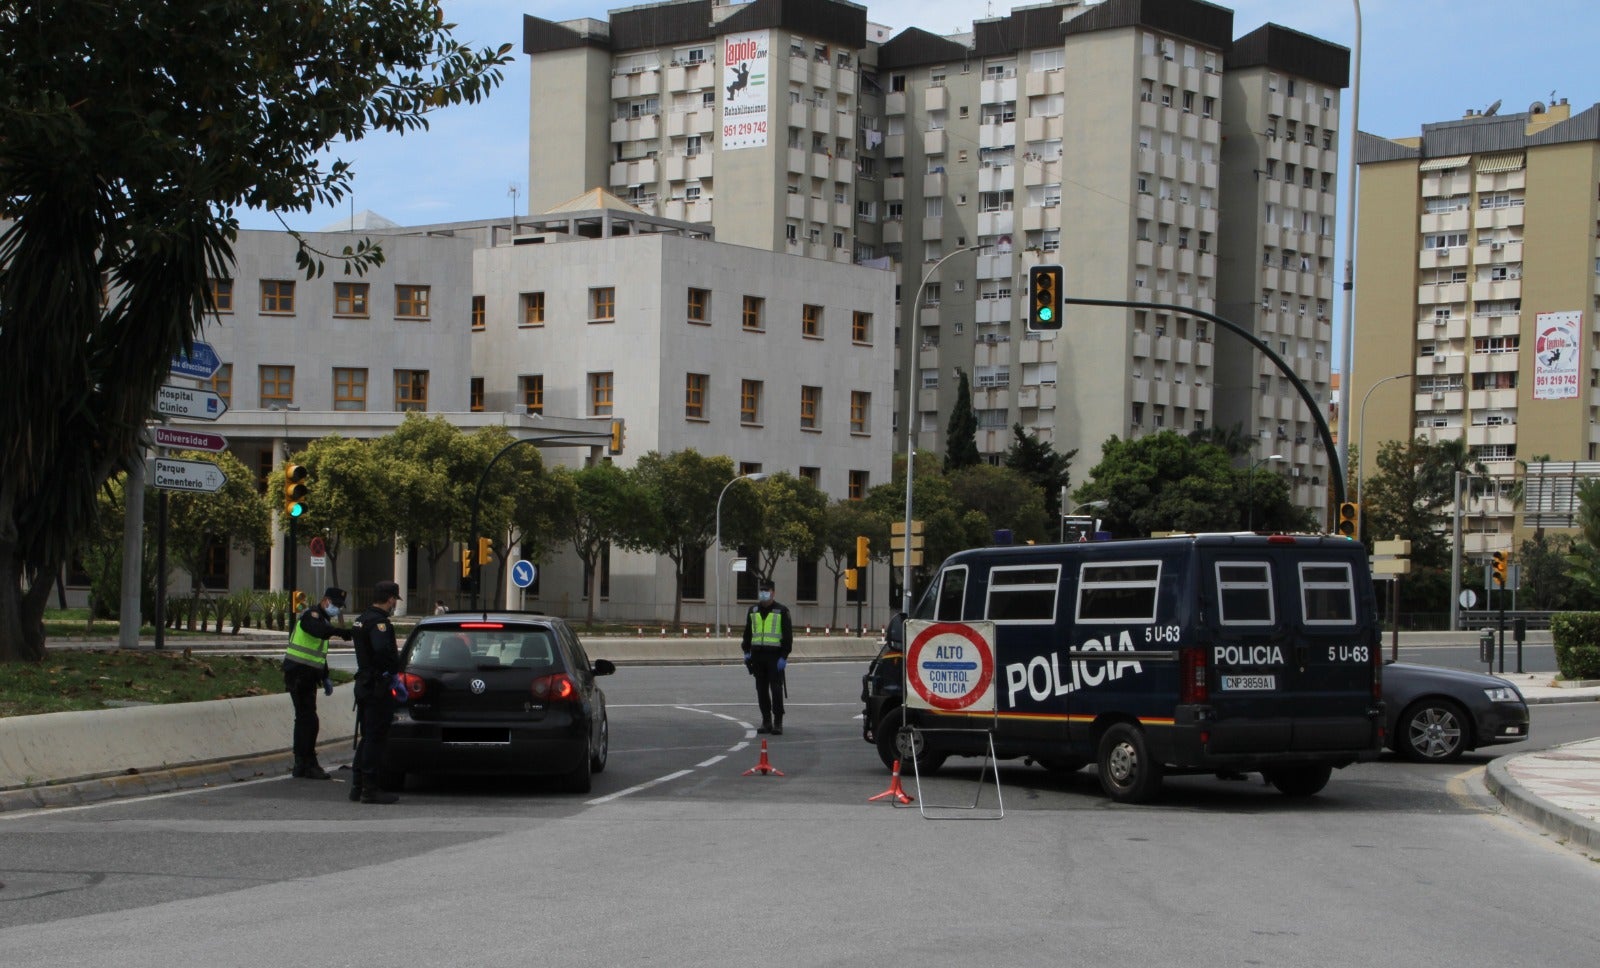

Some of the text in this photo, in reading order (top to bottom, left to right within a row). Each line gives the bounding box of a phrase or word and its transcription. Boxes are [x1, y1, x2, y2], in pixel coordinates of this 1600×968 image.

[726, 38, 756, 66] Lapole
[724, 121, 767, 137] 951 219 742
[1536, 375, 1576, 385] 951 219 742
[159, 388, 194, 402] Hospital
[158, 431, 208, 446] Universidad
[156, 462, 186, 475] Parque
[156, 475, 203, 488] Cementerio
[1145, 627, 1153, 642] 5
[935, 645, 964, 660] ALTO
[1213, 646, 1284, 665] POLICIA
[1328, 647, 1336, 662] 5
[929, 670, 970, 682] CONTROL
[1006, 630, 1143, 708] POLICIA
[932, 682, 967, 694] POLICIA
